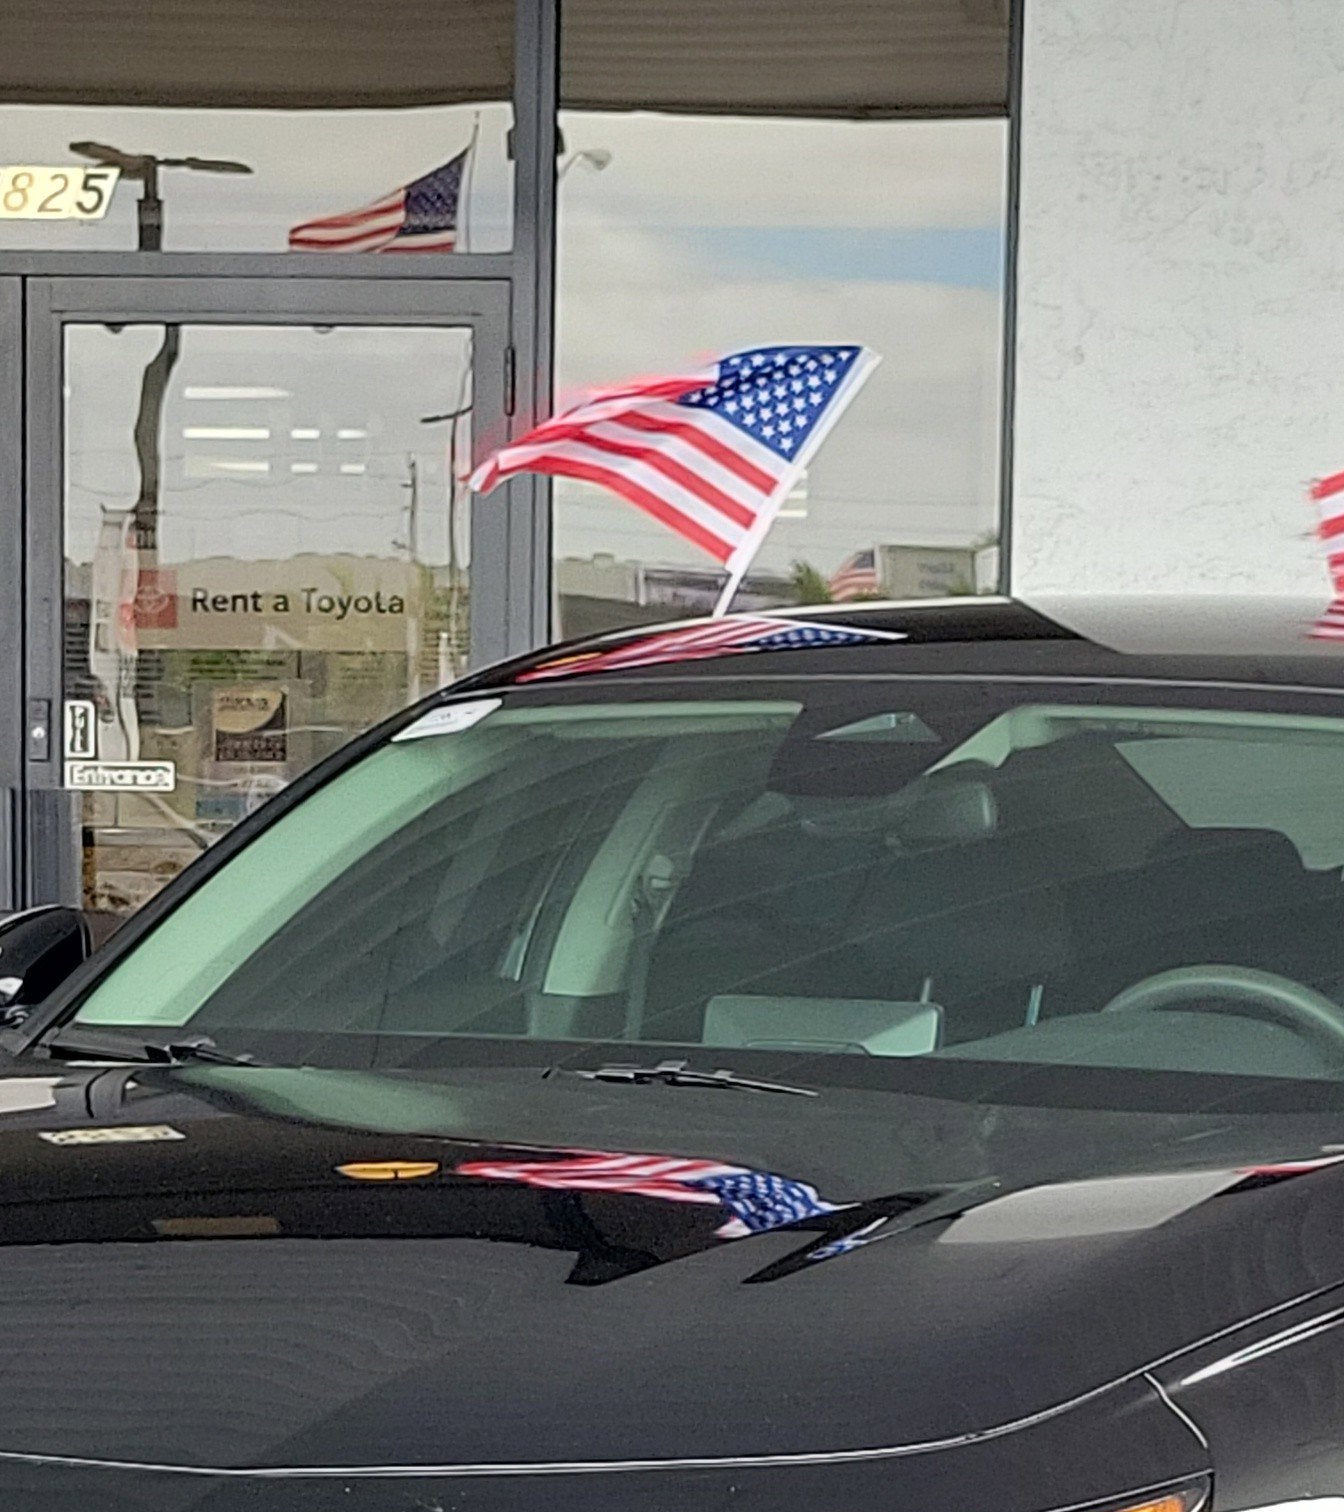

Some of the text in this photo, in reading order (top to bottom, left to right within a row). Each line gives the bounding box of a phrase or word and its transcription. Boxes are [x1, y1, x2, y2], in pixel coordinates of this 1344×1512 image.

[191, 586, 405, 620] Rent a Toyota
